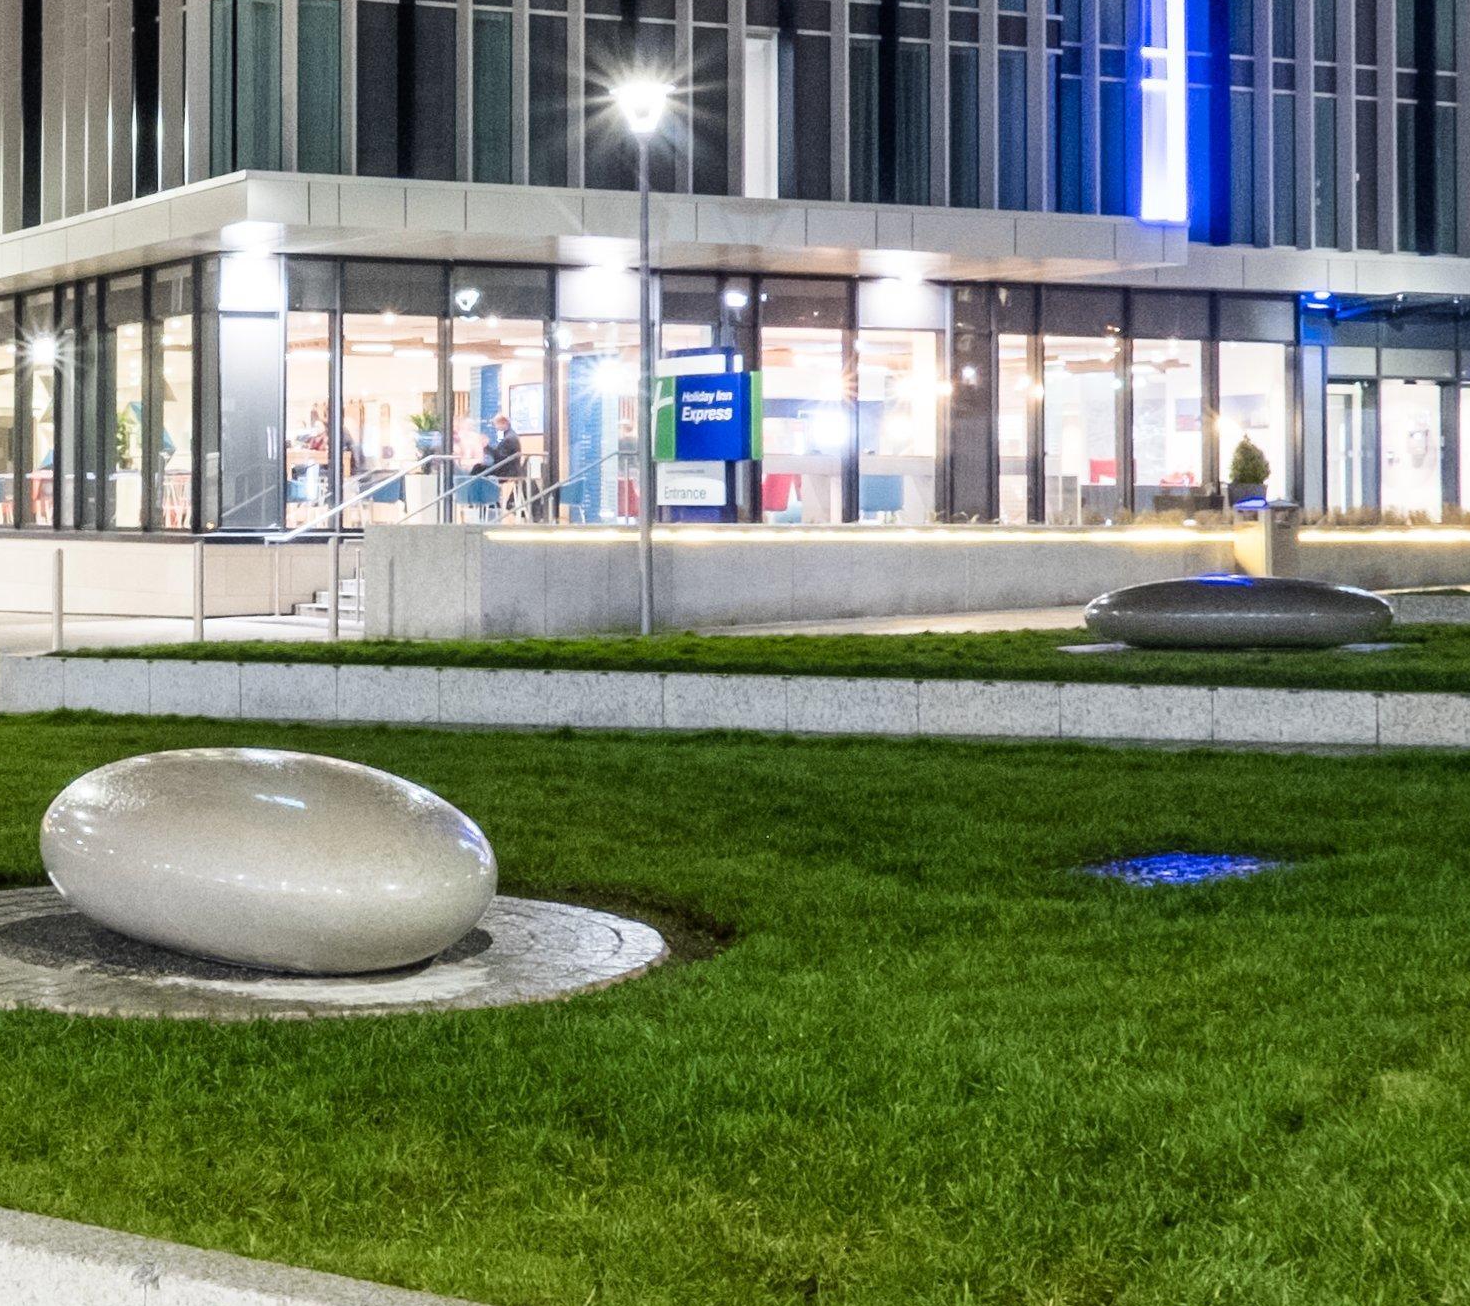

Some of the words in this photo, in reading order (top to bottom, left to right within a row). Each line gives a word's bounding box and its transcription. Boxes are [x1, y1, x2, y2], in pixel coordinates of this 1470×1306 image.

[682, 391, 715, 404] Holiday
[715, 390, 733, 401] Inn
[681, 406, 733, 424] Express
[664, 486, 706, 500] Entrance
